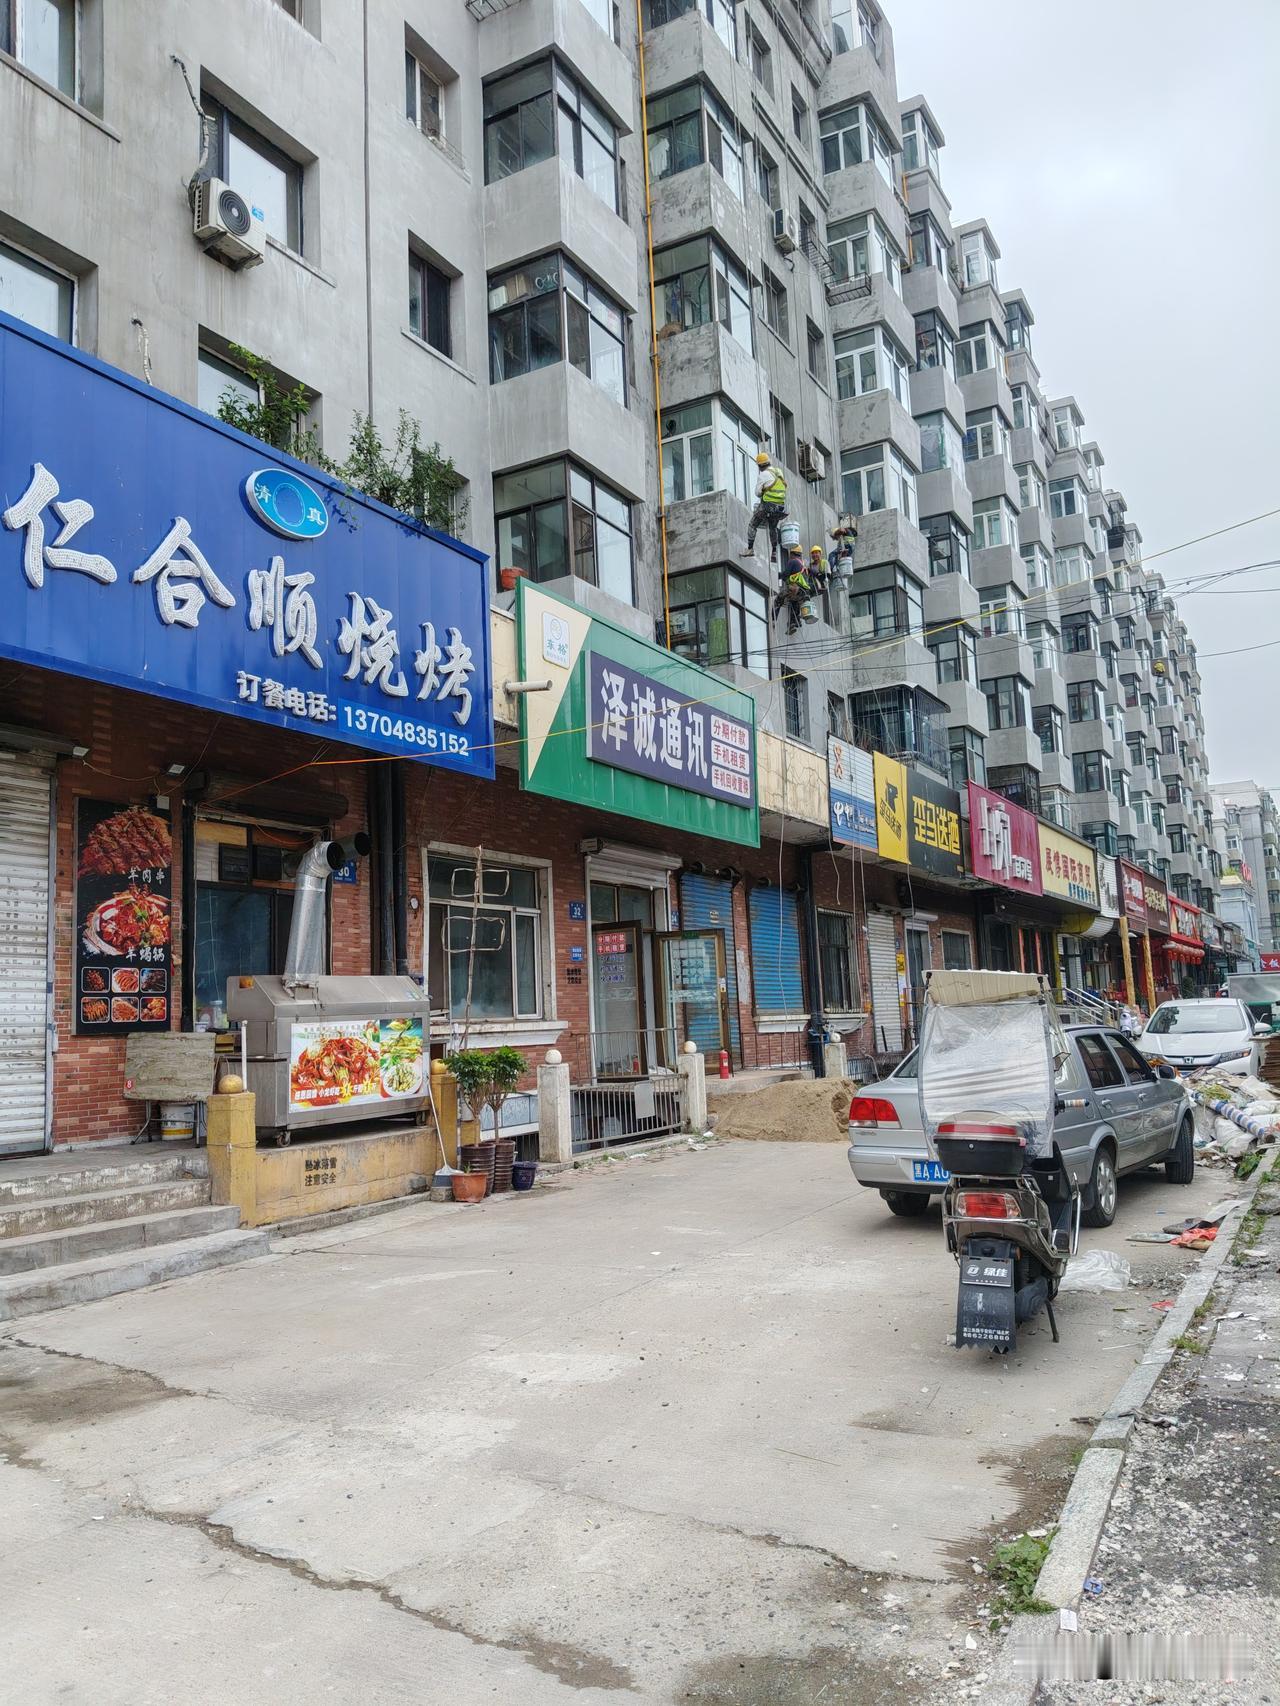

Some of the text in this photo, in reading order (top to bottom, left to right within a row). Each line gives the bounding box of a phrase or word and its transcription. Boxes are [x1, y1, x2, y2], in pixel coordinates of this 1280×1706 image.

[3, 462, 475, 726] 仁合顺烧烤
[344, 706, 469, 756] 13704835152
[601, 667, 708, 779] 泽诚通讯
[713, 719, 746, 746] 分期付款
[713, 744, 746, 770] 手机租赁
[912, 795, 961, 856] 歪马送酒
[128, 867, 165, 885] 羊肉串
[573, 907, 581, 916] 32
[127, 1080, 132, 1089] 8
[305, 1172, 337, 1187] 注意安全
